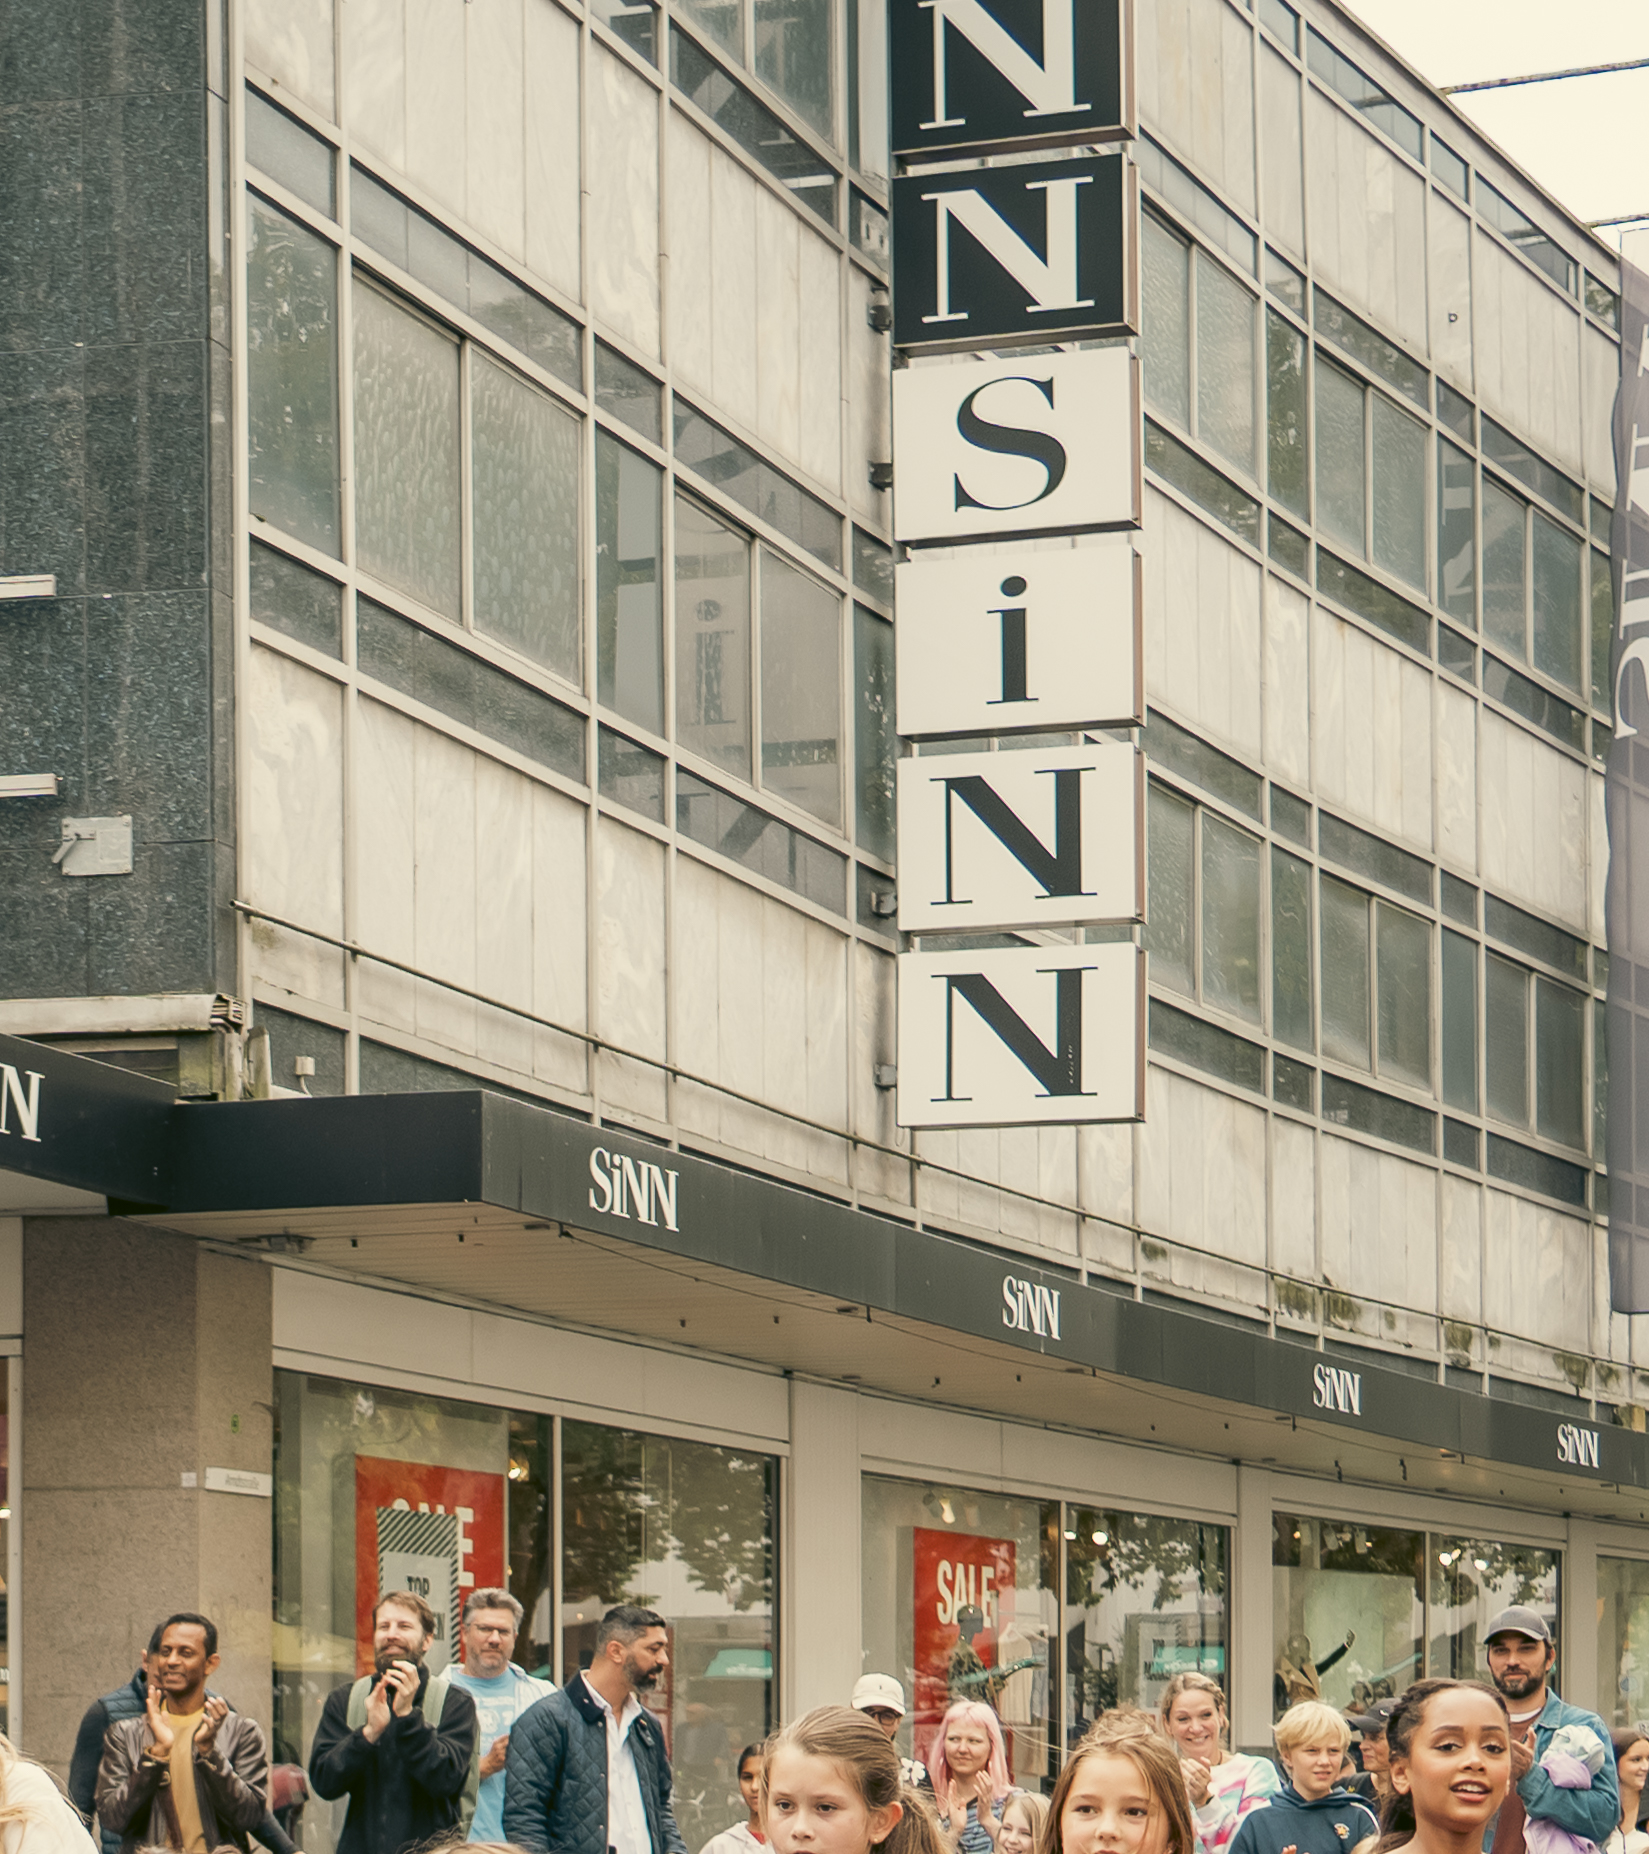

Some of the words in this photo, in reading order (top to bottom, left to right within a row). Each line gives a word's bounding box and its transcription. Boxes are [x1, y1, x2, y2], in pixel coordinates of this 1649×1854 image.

[929, 376, 1098, 1103] SiNN
[588, 1146, 680, 1232] SiNN
[1002, 1275, 1062, 1341] SiNN
[1312, 1362, 1362, 1416] SiNN
[1556, 1423, 1600, 1468] SiNN
[936, 1559, 998, 1629] SALE
